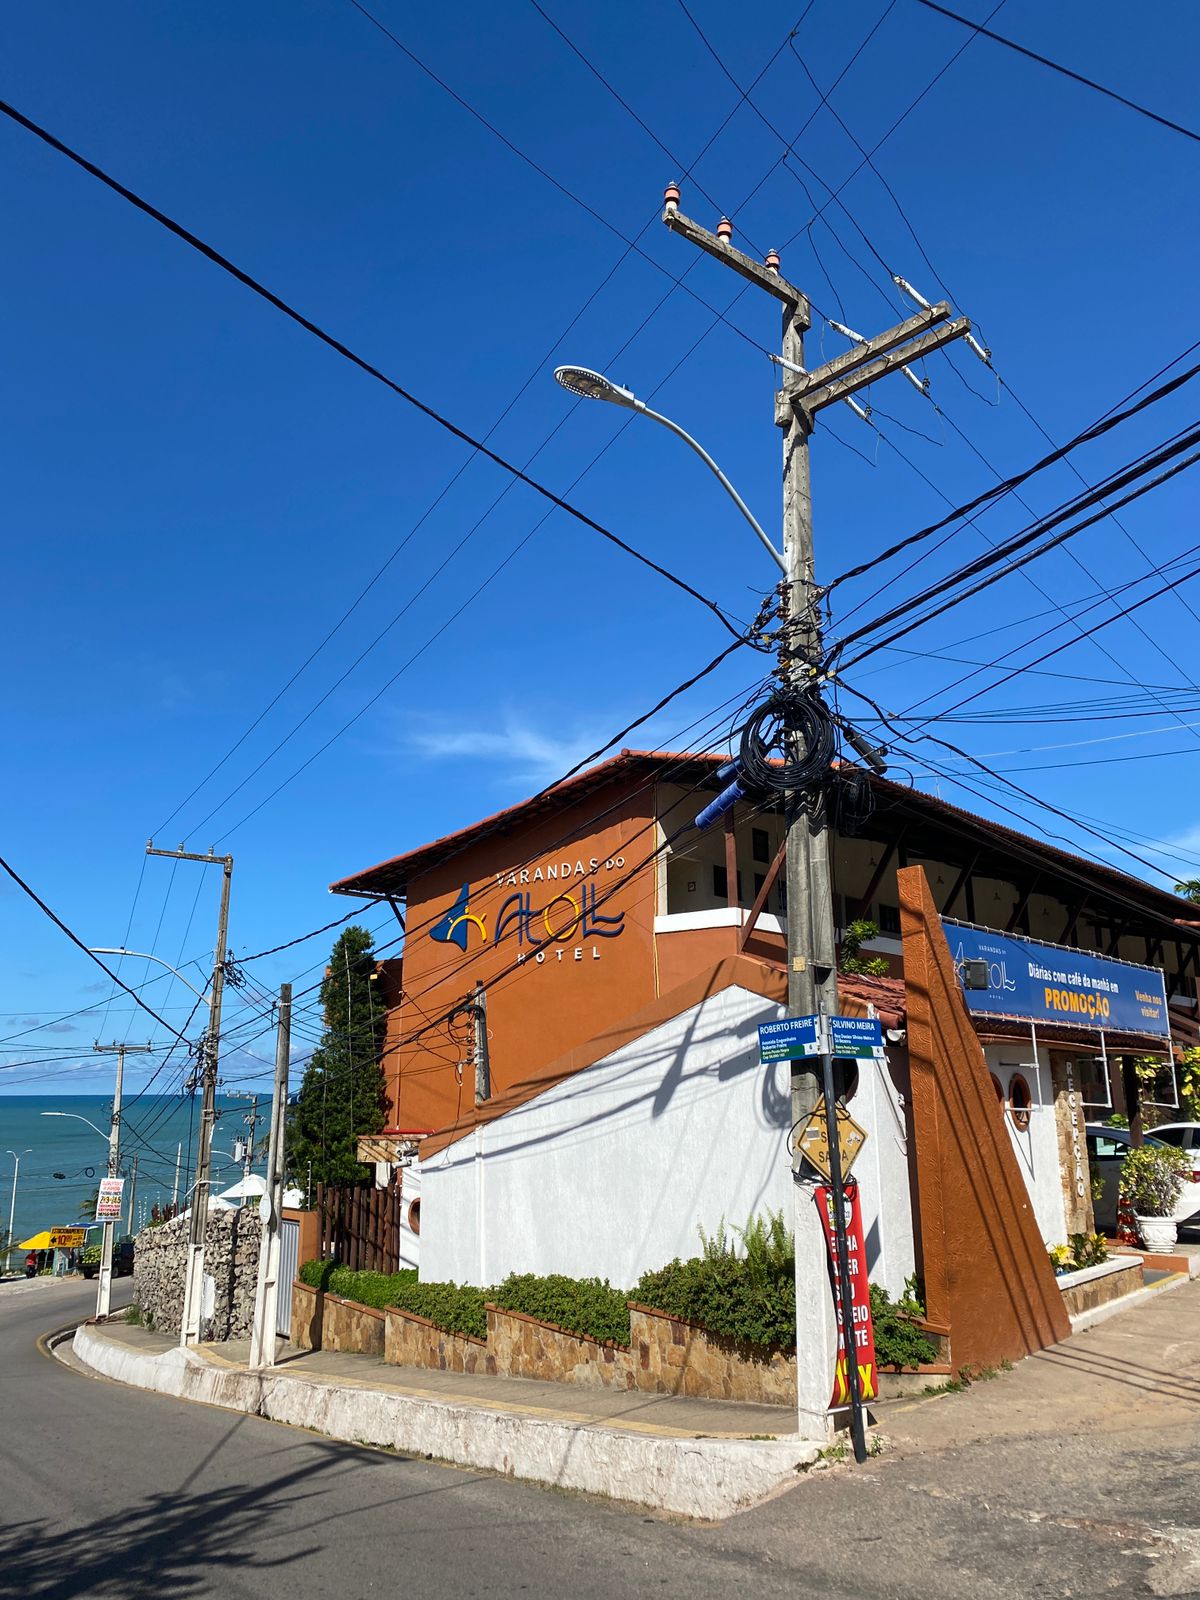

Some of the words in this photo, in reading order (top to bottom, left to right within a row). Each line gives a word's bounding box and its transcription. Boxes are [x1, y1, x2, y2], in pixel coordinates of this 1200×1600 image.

[496, 858, 599, 886] VARANDAS
[606, 857, 625, 870] DO
[517, 946, 601, 963] HOTEL
[1028, 962, 1052, 981] Diárias
[1053, 971, 1067, 984] com
[1067, 972, 1081, 987] café
[1083, 974, 1091, 988] da
[1091, 978, 1110, 992] manhã
[1110, 982, 1119, 994] em
[1044, 987, 1110, 1020] PROMOÇÃO
[760, 1022, 790, 1035] ROBERTO
[790, 1019, 813, 1029] FREIRE
[832, 1020, 855, 1030] SILVINO
[856, 1021, 875, 1031] MEIRA
